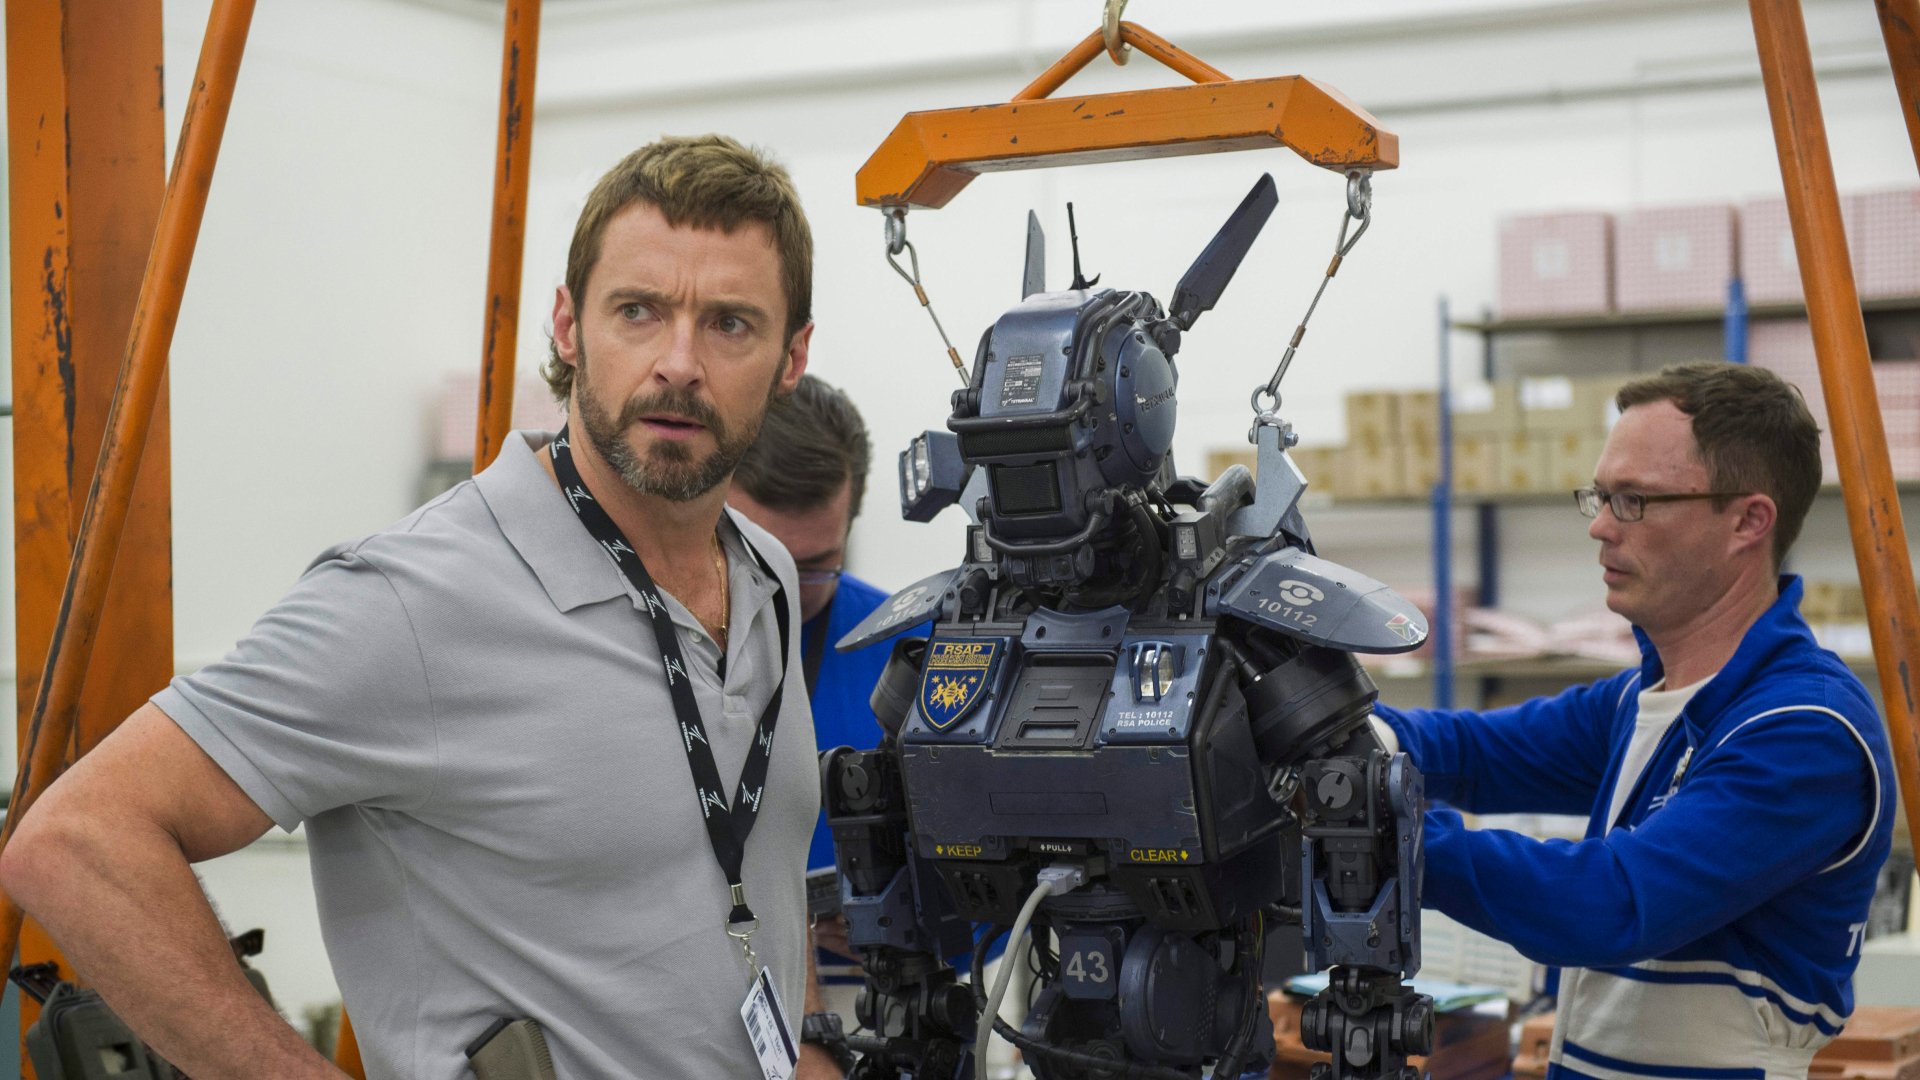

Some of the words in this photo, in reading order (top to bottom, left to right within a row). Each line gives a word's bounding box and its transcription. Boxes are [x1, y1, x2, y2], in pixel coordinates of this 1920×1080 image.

[1258, 598, 1318, 627] 10112
[943, 644, 982, 655] RSAP
[1119, 711, 1137, 719] TEL
[1145, 710, 1174, 719] 10112
[1117, 719, 1135, 727] RSA
[1137, 718, 1172, 727] POLICE
[946, 844, 982, 857] KEEP
[1046, 844, 1068, 852] PULL
[1130, 849, 1178, 862] CLEAR
[1066, 950, 1109, 983] 43
